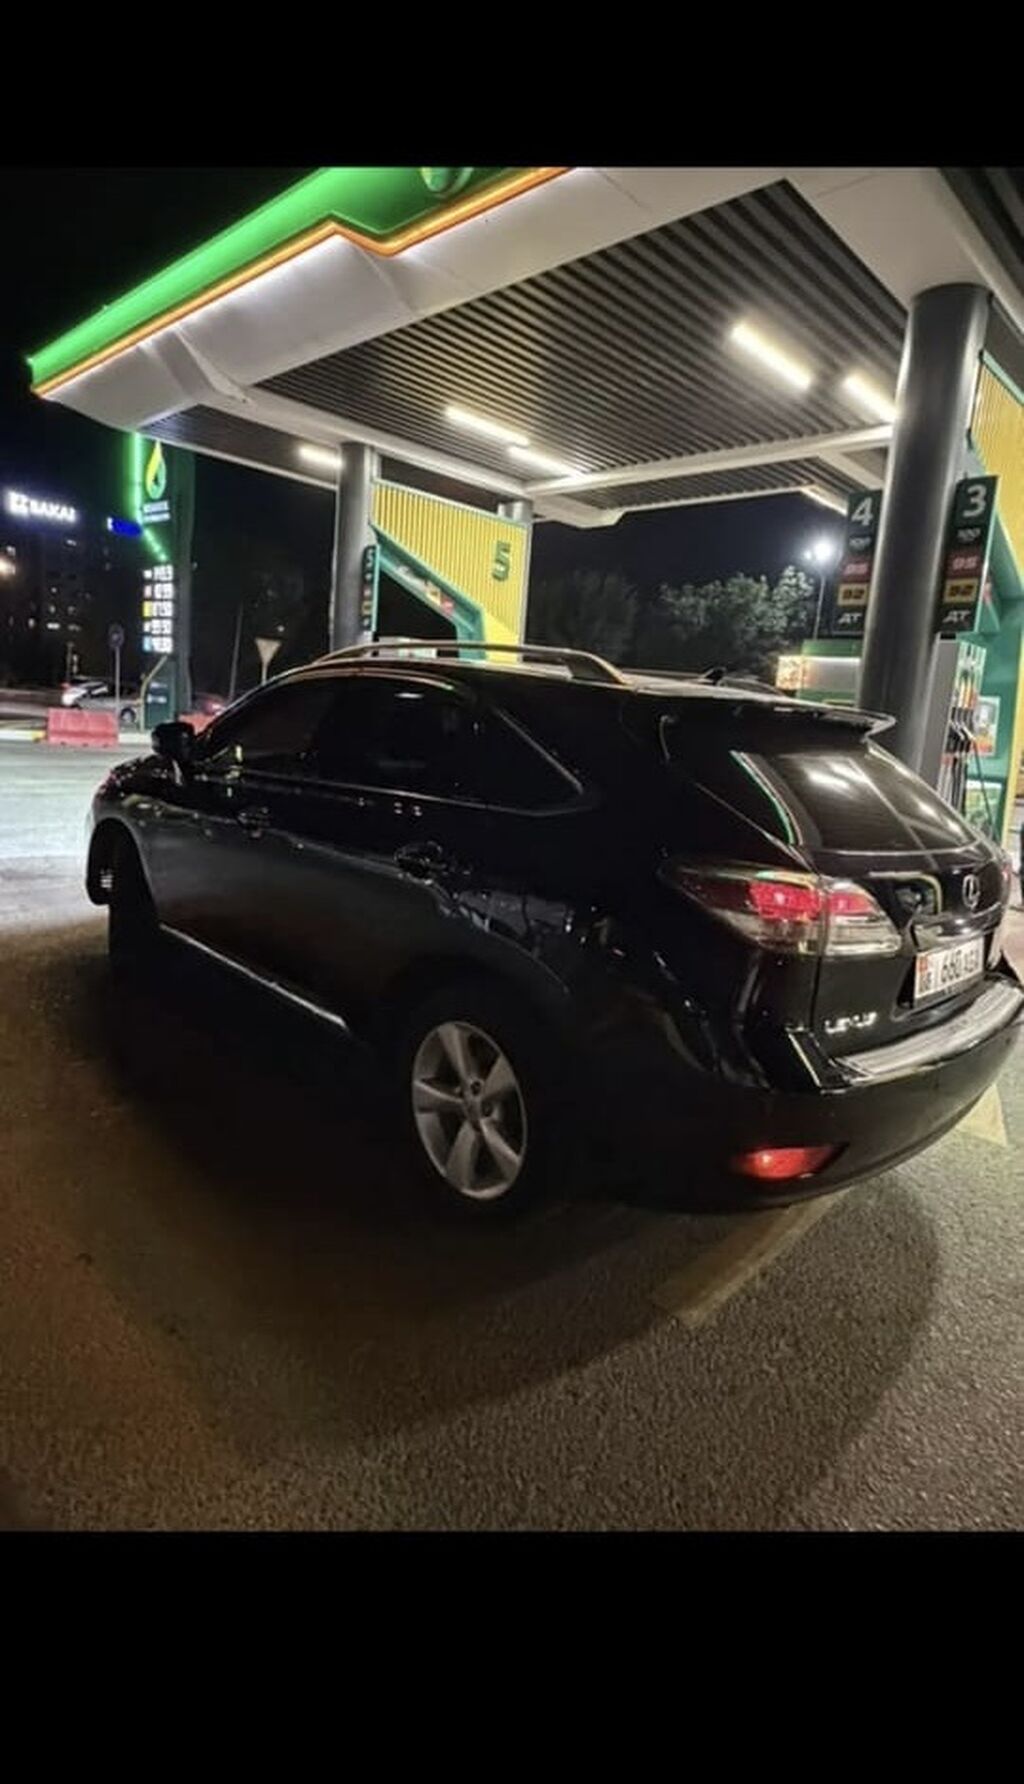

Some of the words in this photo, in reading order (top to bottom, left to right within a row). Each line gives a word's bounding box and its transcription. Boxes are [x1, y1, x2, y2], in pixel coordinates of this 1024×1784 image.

[851, 497, 874, 526] 4
[962, 484, 987, 517] 3
[492, 540, 511, 582] 5
